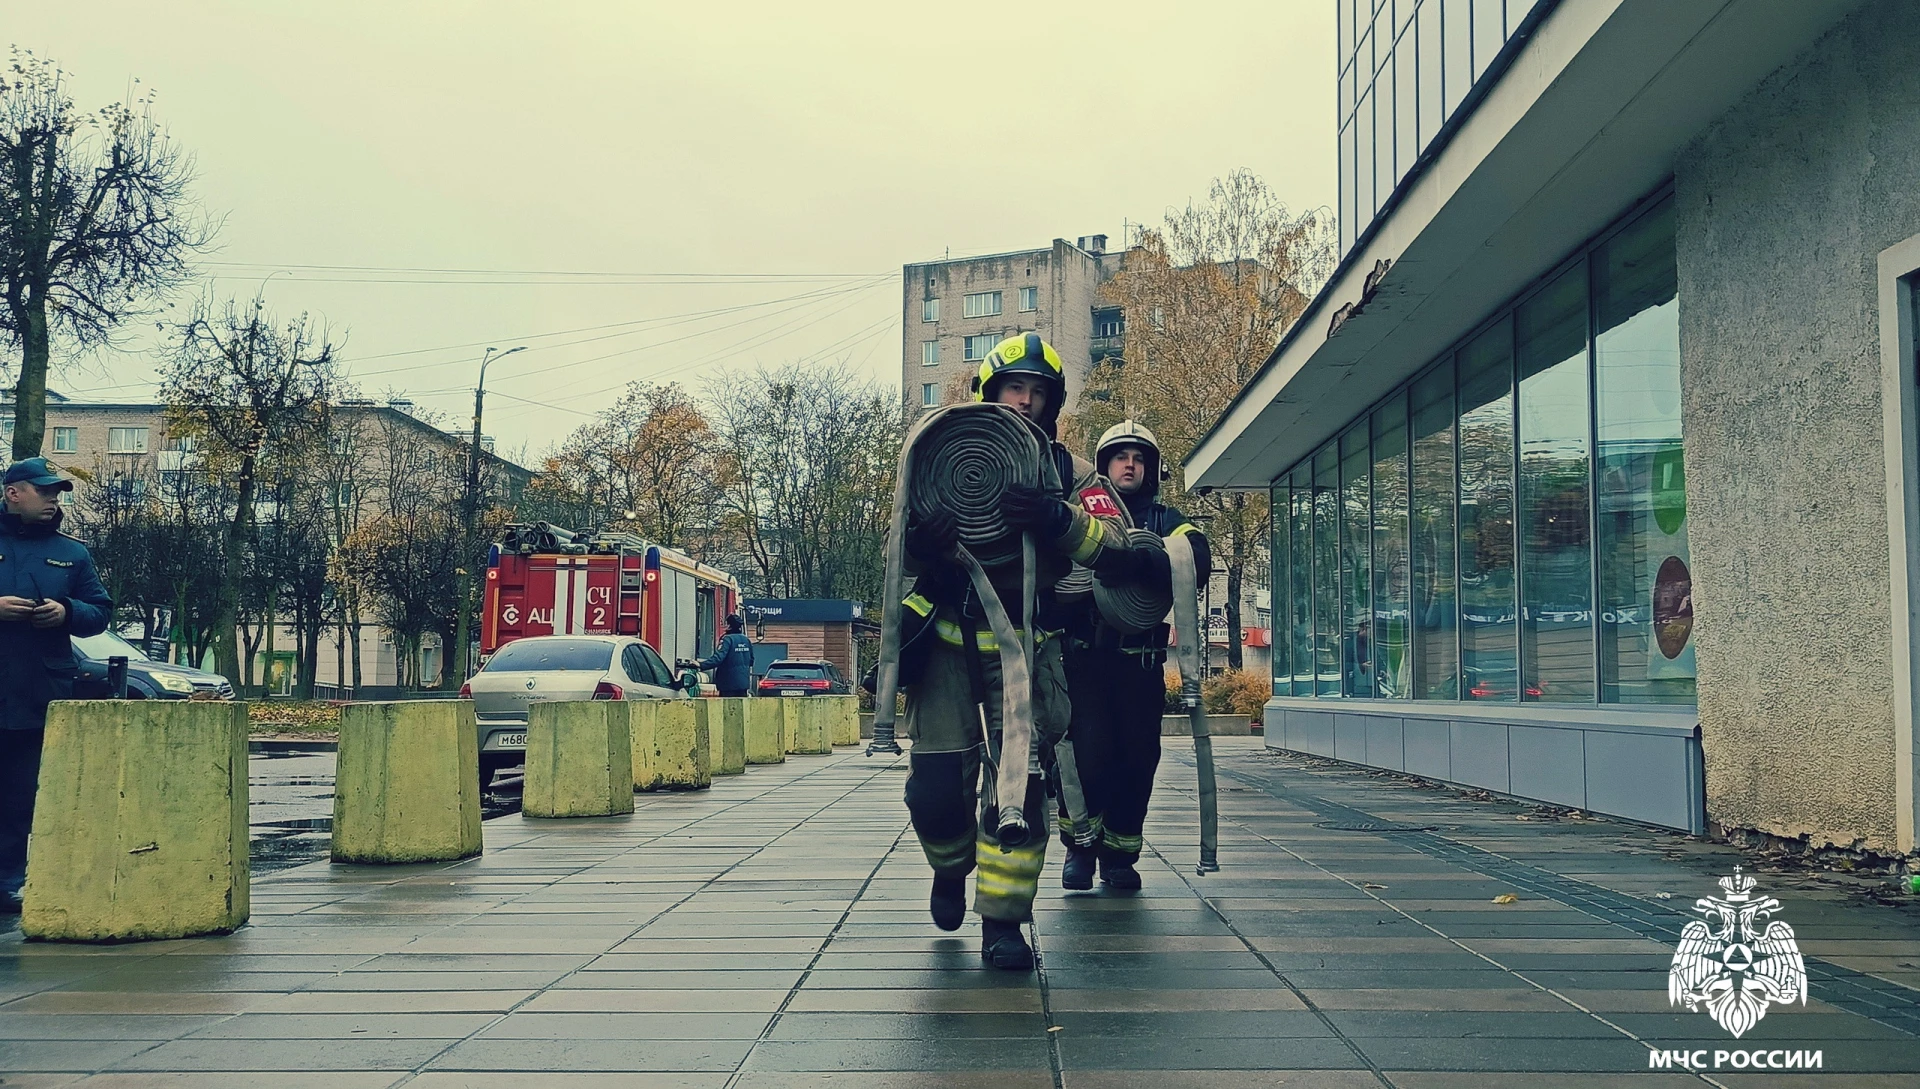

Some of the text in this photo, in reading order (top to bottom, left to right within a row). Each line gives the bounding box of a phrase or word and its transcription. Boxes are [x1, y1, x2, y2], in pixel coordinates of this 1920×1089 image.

[587, 586, 611, 605] СЧ
[527, 607, 554, 627] АЦ
[593, 607, 605, 625] 2
